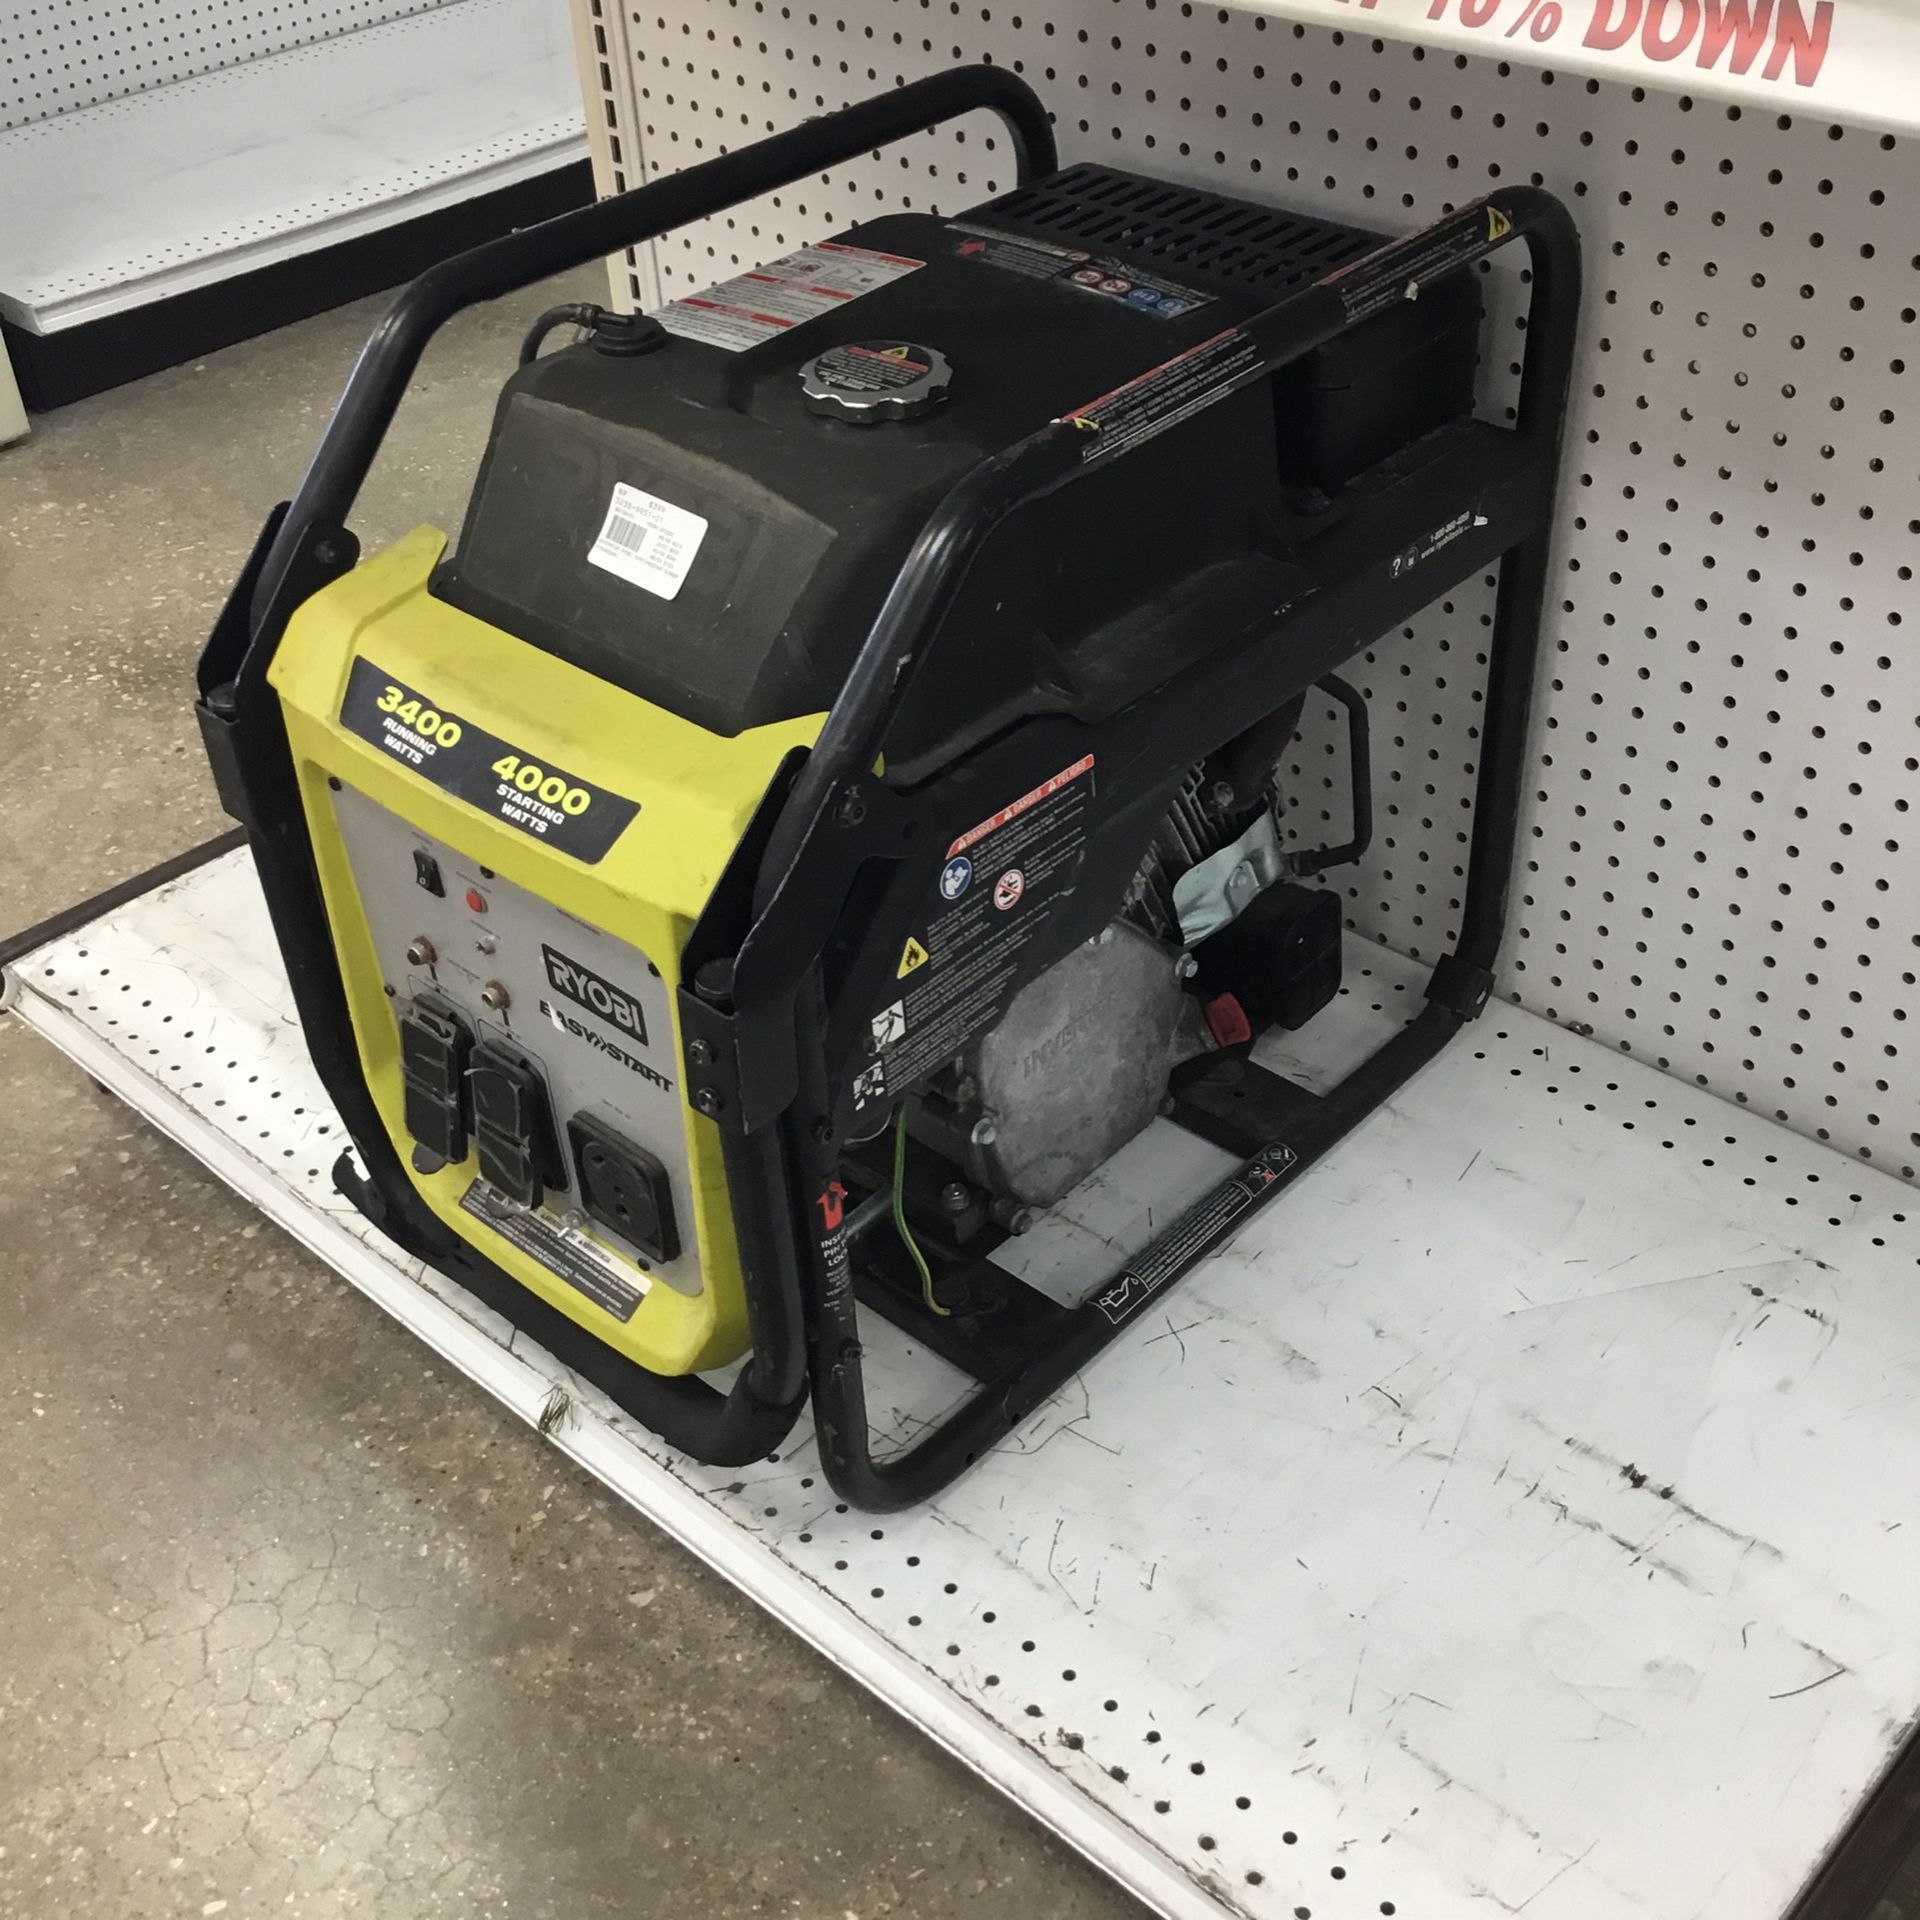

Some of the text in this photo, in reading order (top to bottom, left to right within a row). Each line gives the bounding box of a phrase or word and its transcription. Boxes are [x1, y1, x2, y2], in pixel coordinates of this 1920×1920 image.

[1580, 0, 1834, 87] DOWN
[377, 686, 462, 747] 3400
[382, 717, 437, 756] RUNNING
[384, 734, 424, 765] WATTS
[492, 755, 591, 815] 4000
[496, 784, 565, 825] STARTING
[501, 802, 549, 834] WATTS
[548, 953, 643, 1036] RYOBI
[606, 1042, 674, 1092] START
